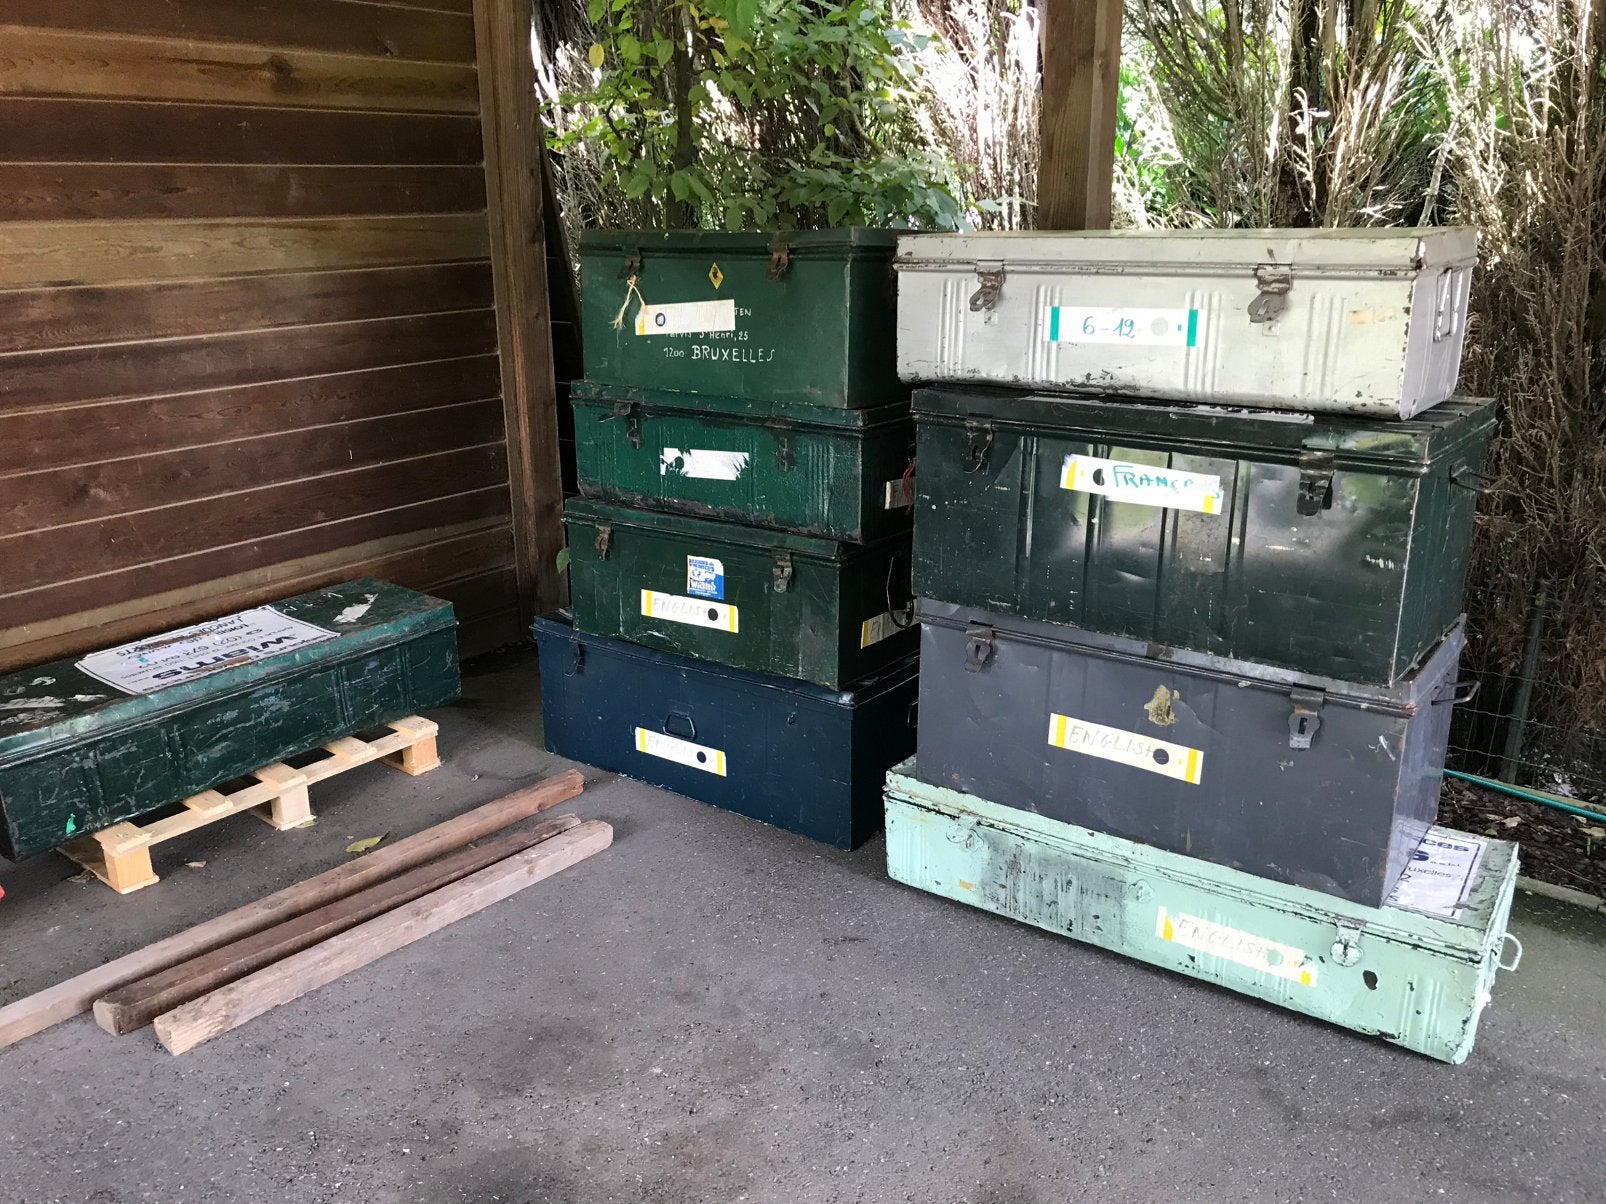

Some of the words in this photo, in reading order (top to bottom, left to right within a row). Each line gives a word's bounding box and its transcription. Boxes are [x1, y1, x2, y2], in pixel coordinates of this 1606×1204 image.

[734, 307, 752, 317] TEN
[738, 331, 749, 341] 25
[663, 347, 685, 358] 1200
[691, 345, 776, 364] BRUXELLES
[152, 635, 296, 680] wiams
